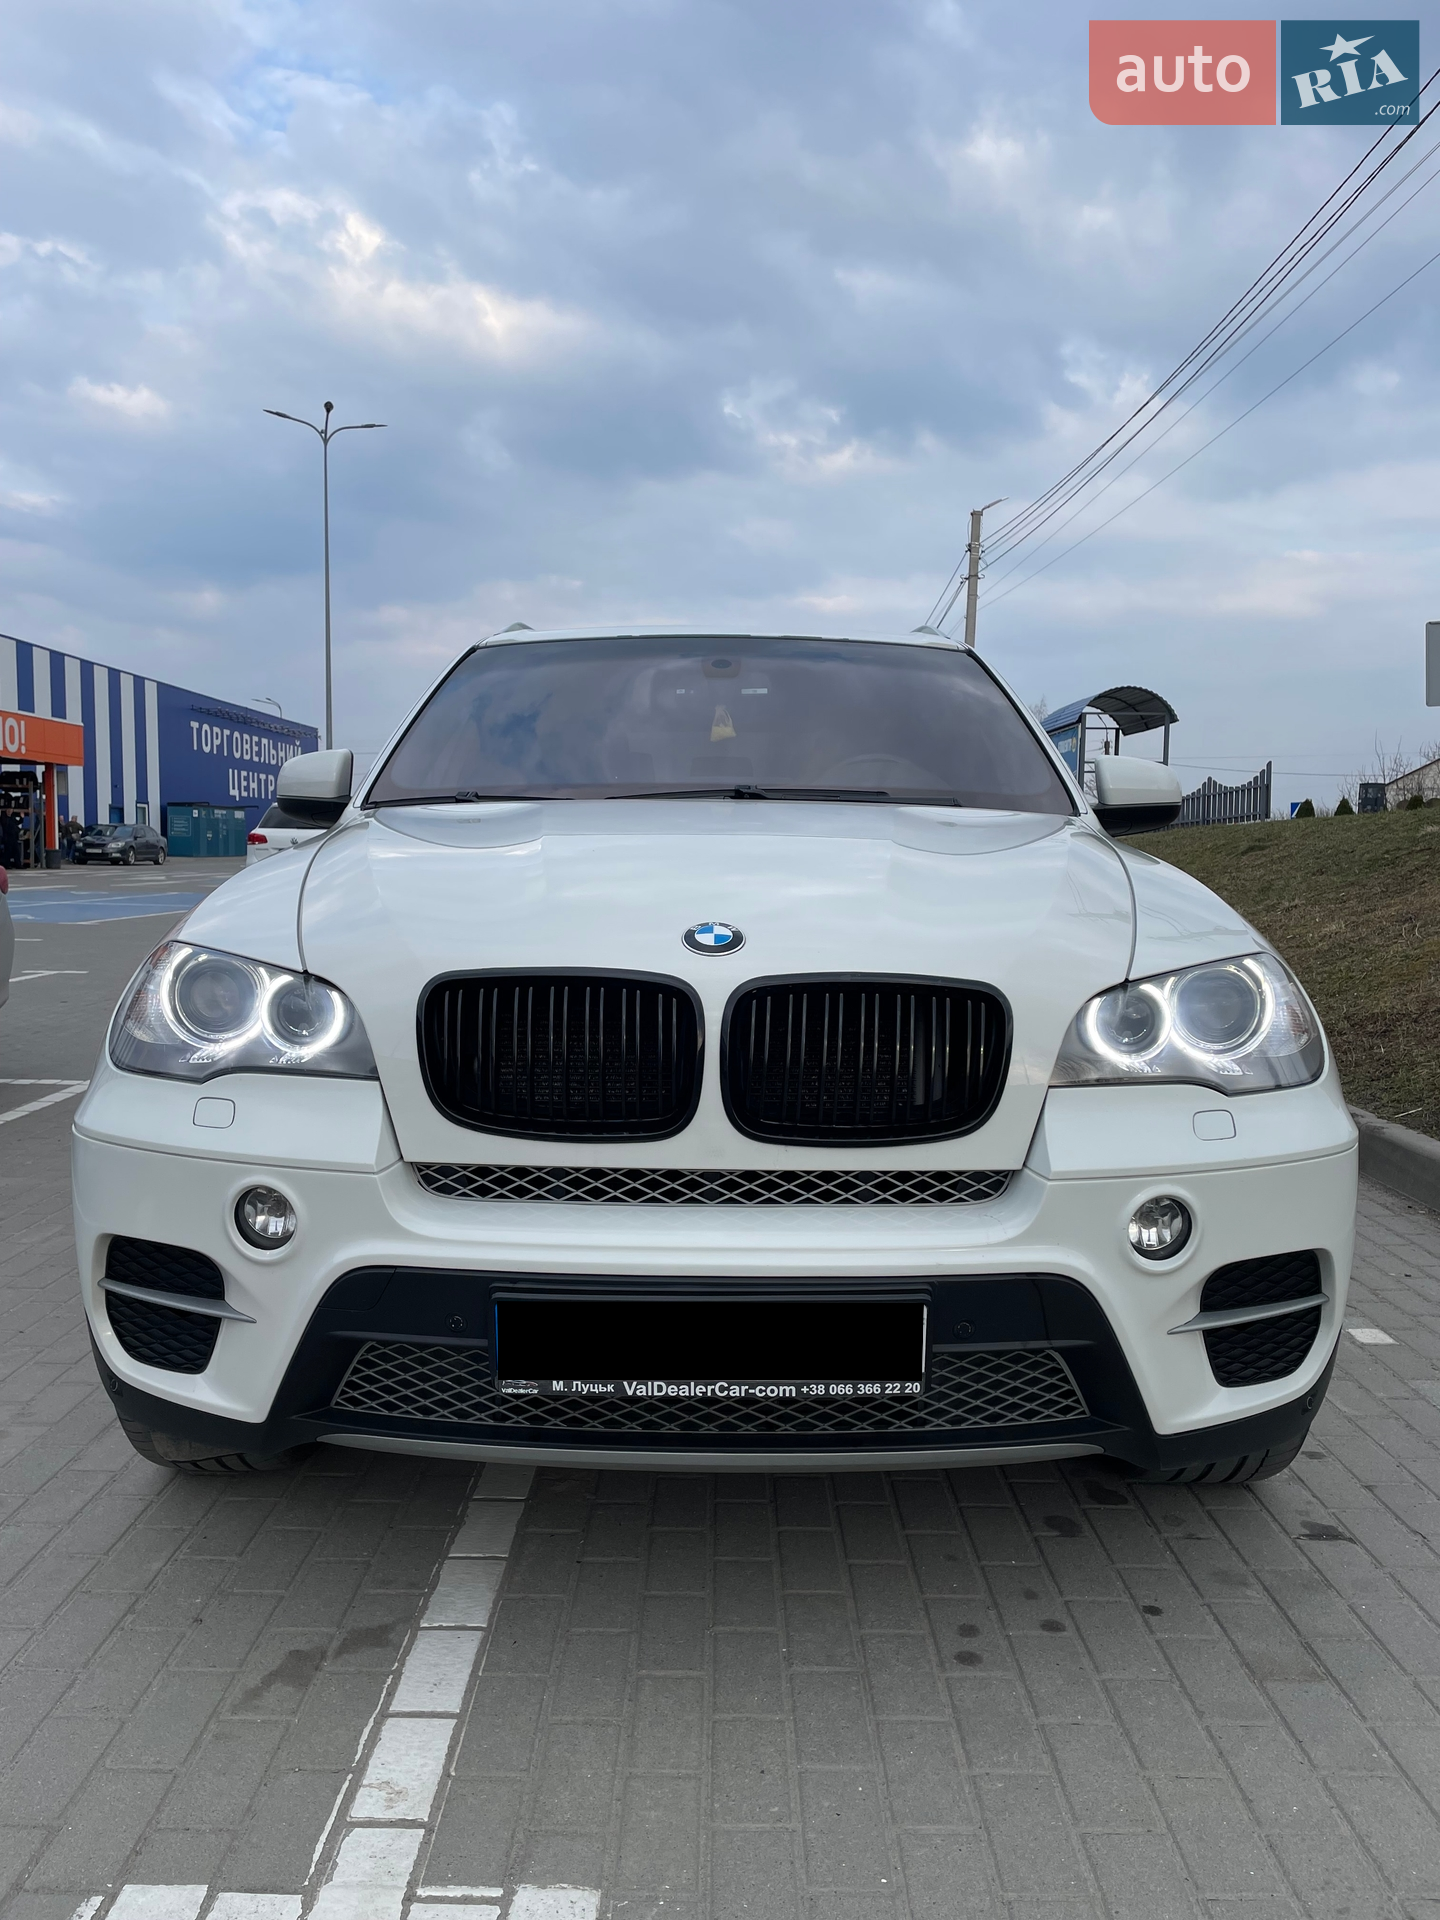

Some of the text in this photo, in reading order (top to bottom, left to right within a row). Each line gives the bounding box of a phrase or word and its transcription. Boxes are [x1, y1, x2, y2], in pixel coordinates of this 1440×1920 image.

[0, 715, 26, 755] О!
[228, 768, 275, 801] ЦЕНТР
[571, 1381, 615, 1395] Луцьк
[623, 1381, 796, 1397] ValDealerCar-com
[800, 1382, 921, 1395] +38 066 366 22 20
